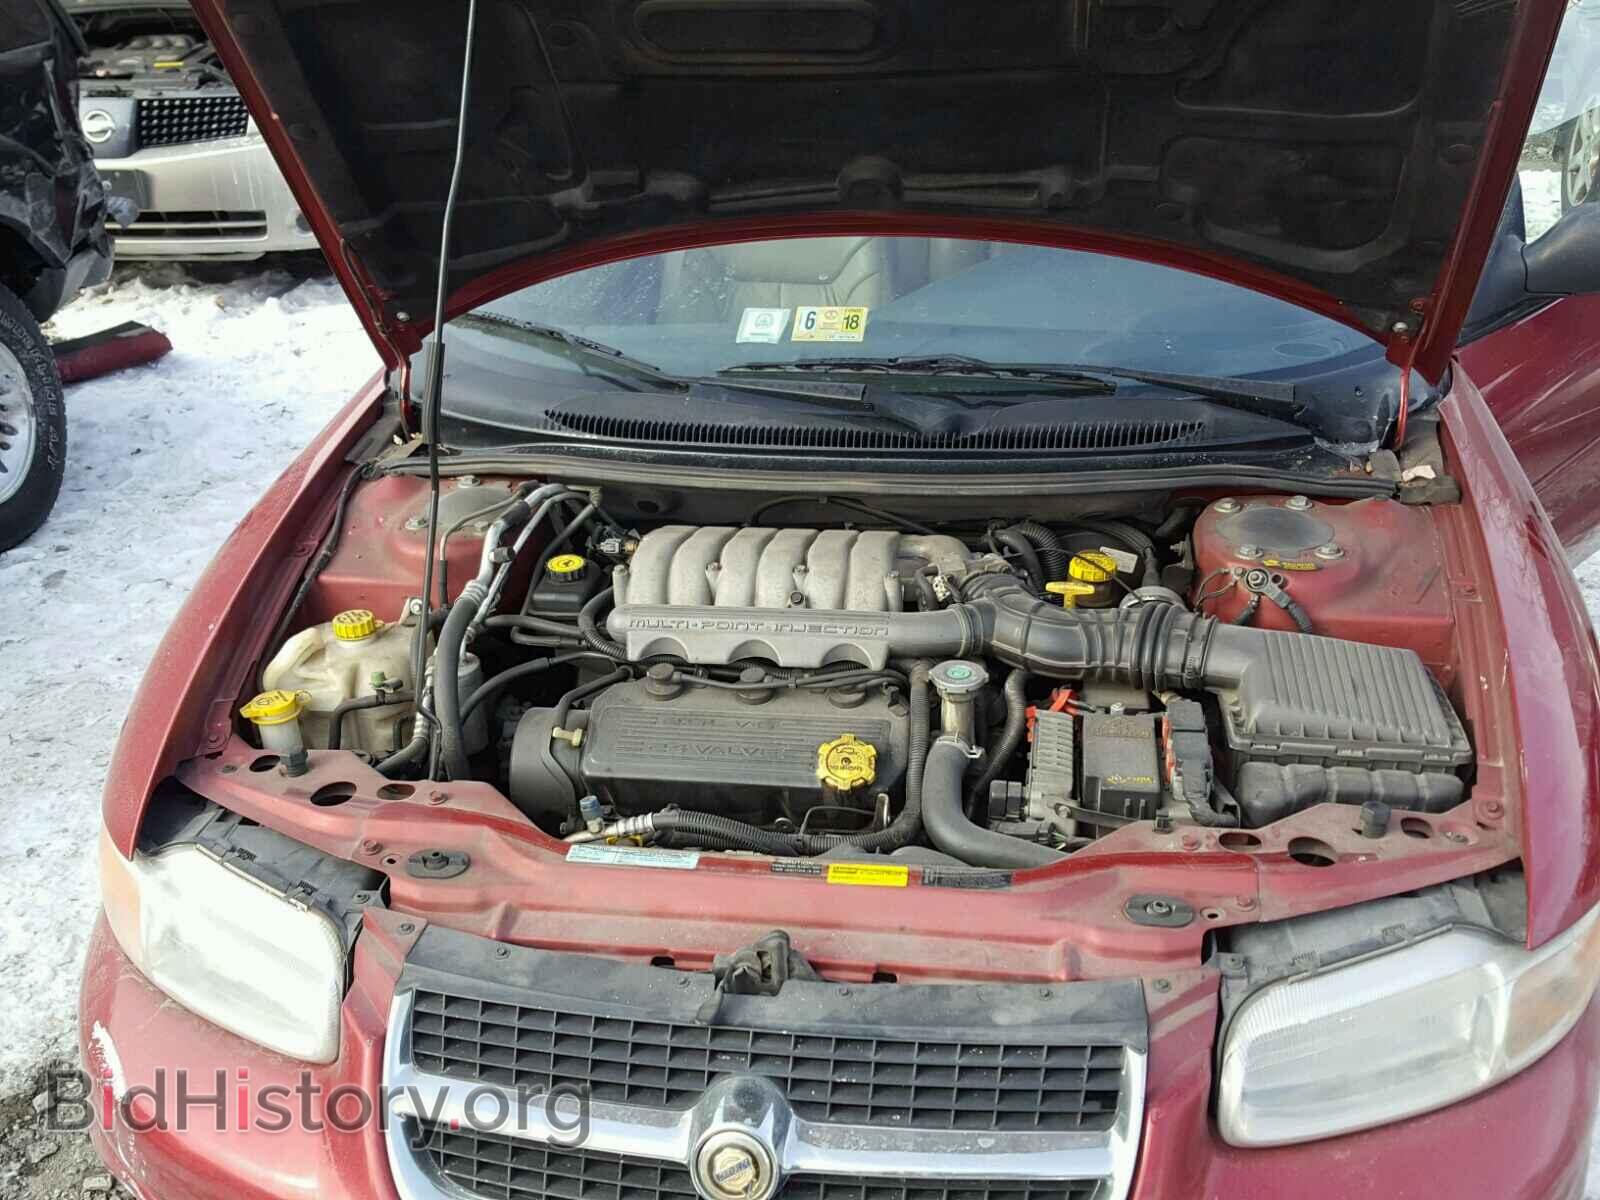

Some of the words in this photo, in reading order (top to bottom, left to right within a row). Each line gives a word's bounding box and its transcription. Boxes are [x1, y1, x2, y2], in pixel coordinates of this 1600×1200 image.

[805, 311, 816, 330] 6
[843, 314, 860, 330] 18
[773, 622, 889, 637] INJECTION
